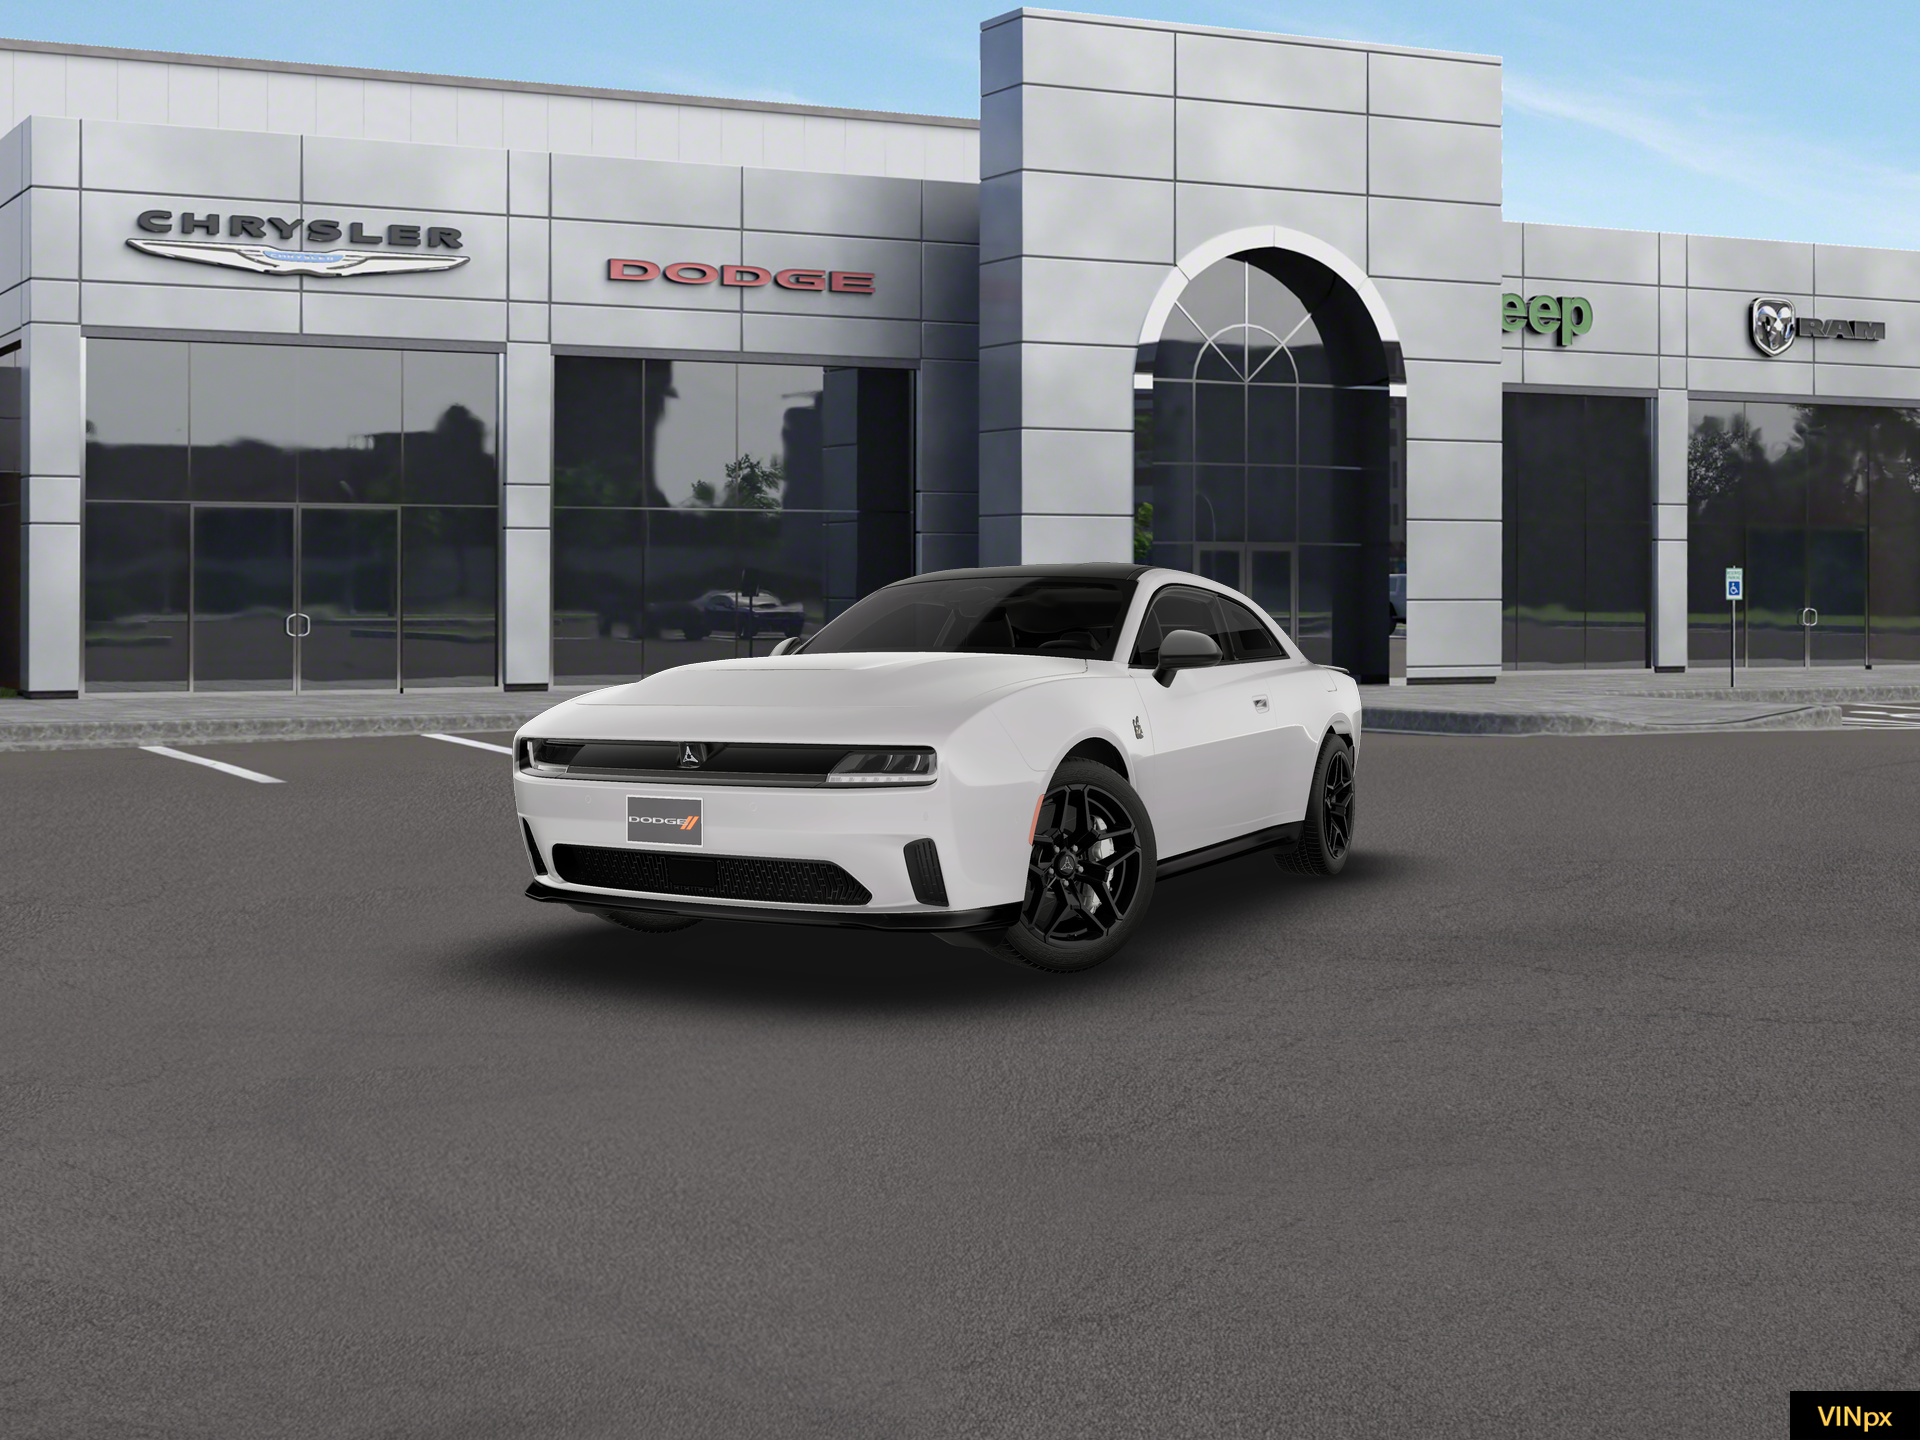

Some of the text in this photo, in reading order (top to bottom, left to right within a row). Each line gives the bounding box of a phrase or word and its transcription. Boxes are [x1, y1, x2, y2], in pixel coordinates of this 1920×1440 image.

[138, 210, 464, 248] CHRYSLER
[270, 253, 334, 261] CHRYSLER
[607, 258, 876, 294] DODGE
[1502, 293, 1593, 346] eep
[1796, 317, 1886, 341] RAM
[628, 816, 689, 825] DODGE
